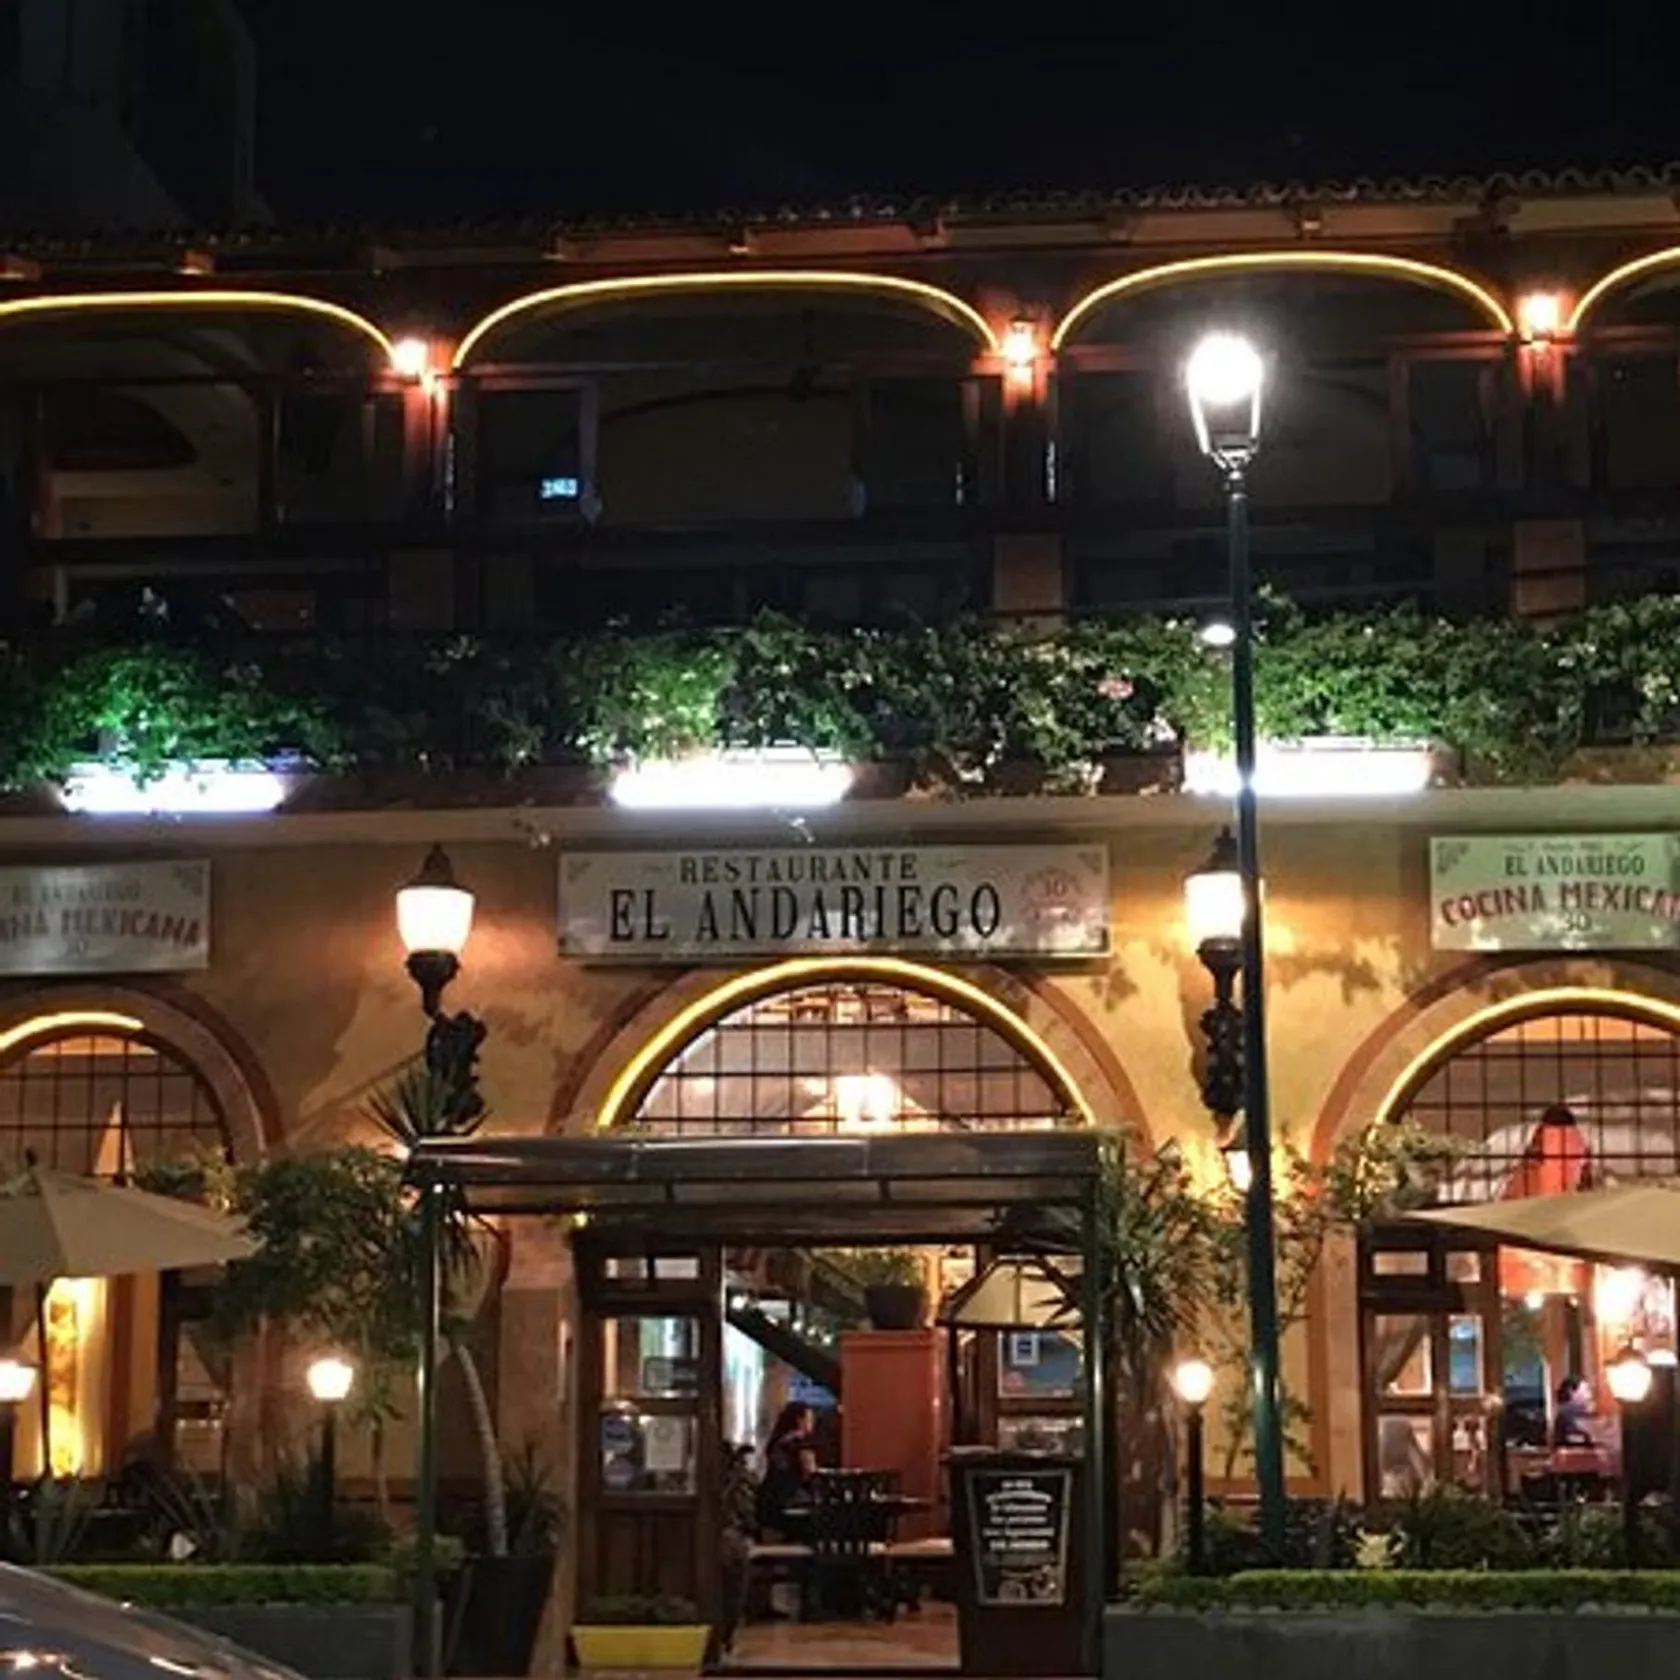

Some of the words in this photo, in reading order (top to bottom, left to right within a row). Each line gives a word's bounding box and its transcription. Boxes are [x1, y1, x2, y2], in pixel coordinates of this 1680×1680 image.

[679, 853, 918, 884] RESTAURANTE
[1504, 854, 1528, 877] EL
[1536, 853, 1646, 877] ANDARIEGO
[609, 888, 670, 940] EL
[696, 882, 1001, 941] ANDARIEGO
[1441, 882, 1546, 928] COCINA
